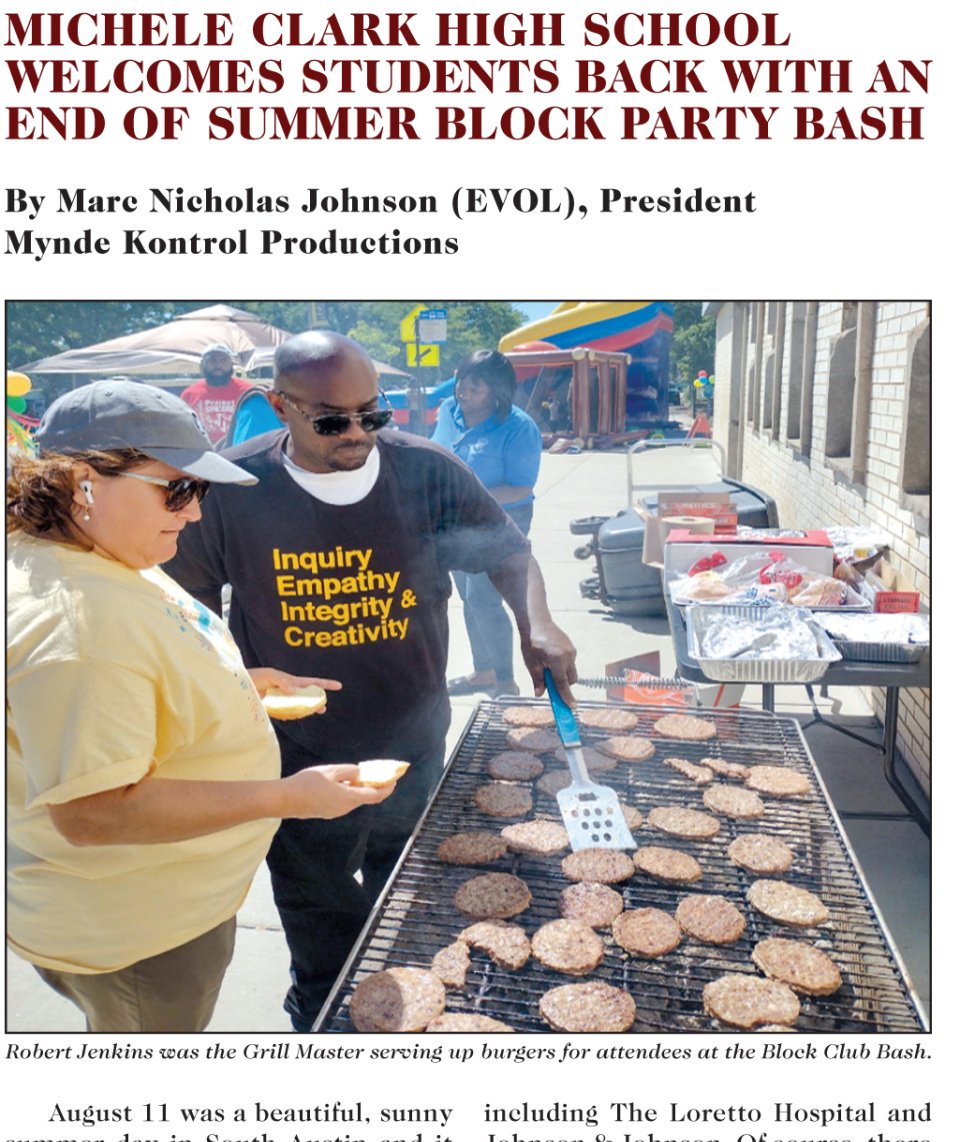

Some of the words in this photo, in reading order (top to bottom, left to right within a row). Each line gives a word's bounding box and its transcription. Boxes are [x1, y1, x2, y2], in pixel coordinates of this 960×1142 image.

[3, 12, 234, 47] MICHELE
[252, 12, 421, 47] CLARK
[435, 12, 566, 47] HIGH
[584, 12, 791, 47] SCHOOL
[4, 59, 285, 94] WELCOMES
[302, 59, 560, 94] STUDENTS
[575, 59, 708, 94] BACK
[720, 59, 853, 94] WITH
[865, 59, 933, 94] AN
[5, 106, 106, 141] END
[123, 106, 190, 141] OF
[208, 106, 421, 141] SUMMER
[435, 106, 607, 141] BLOCK
[620, 106, 780, 140] PARTY
[793, 106, 925, 141] BASH
[4, 188, 46, 221] By
[56, 188, 138, 213] Marc
[148, 186, 290, 213] Nicholas
[301, 187, 438, 213] Johnson
[451, 186, 588, 221] (EVOL),
[600, 186, 757, 213] President
[4, 228, 111, 262] Mynde
[123, 228, 248, 255] Kontrol
[260, 228, 459, 255] Productions
[273, 546, 373, 574] Inquiry
[276, 570, 401, 600] Empathy
[280, 597, 394, 626] Integrity
[401, 588, 417, 608] &
[284, 617, 409, 648] Creativity
[48, 1103, 132, 1127] August
[143, 1103, 168, 1122] 11
[180, 1108, 225, 1122] was
[233, 1108, 247, 1122] a
[255, 1101, 370, 1124] beautiful,
[380, 1108, 453, 1127] sunny
[484, 1102, 599, 1127] including
[610, 1102, 657, 1122] The
[670, 1102, 762, 1122] Loretto
[774, 1101, 875, 1127] Hospital
[887, 1102, 932, 1122] and
